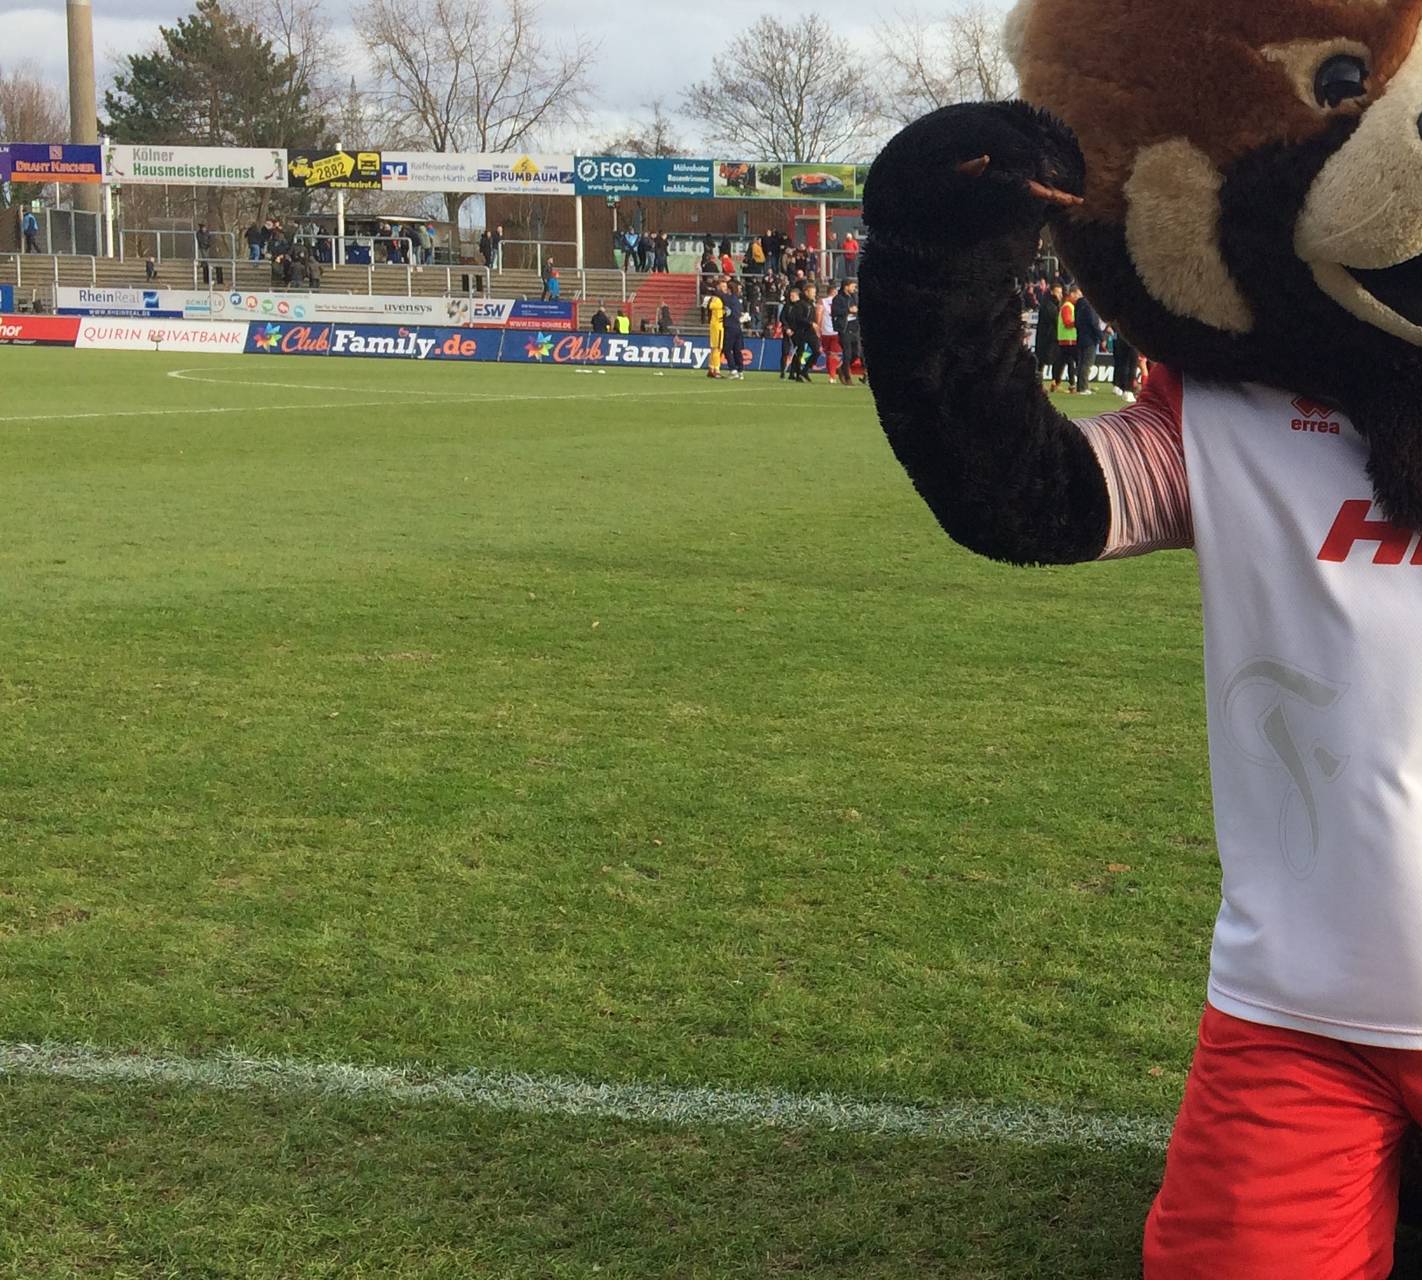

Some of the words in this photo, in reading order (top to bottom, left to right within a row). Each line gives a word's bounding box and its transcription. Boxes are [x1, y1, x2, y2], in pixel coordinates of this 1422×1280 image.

[132, 148, 174, 162] Kölner
[133, 163, 255, 178] Hausmeisterdienst
[316, 162, 346, 180] 2882
[493, 171, 558, 182] PRUMBAUM
[600, 162, 636, 178] FGO
[79, 289, 140, 303] RheinReal
[474, 304, 506, 317] ESW
[83, 327, 142, 342] QUIRIN
[148, 328, 241, 344] PRIVATBANK
[281, 326, 330, 352] Club
[331, 328, 477, 359] Family.de
[552, 335, 604, 363] Club
